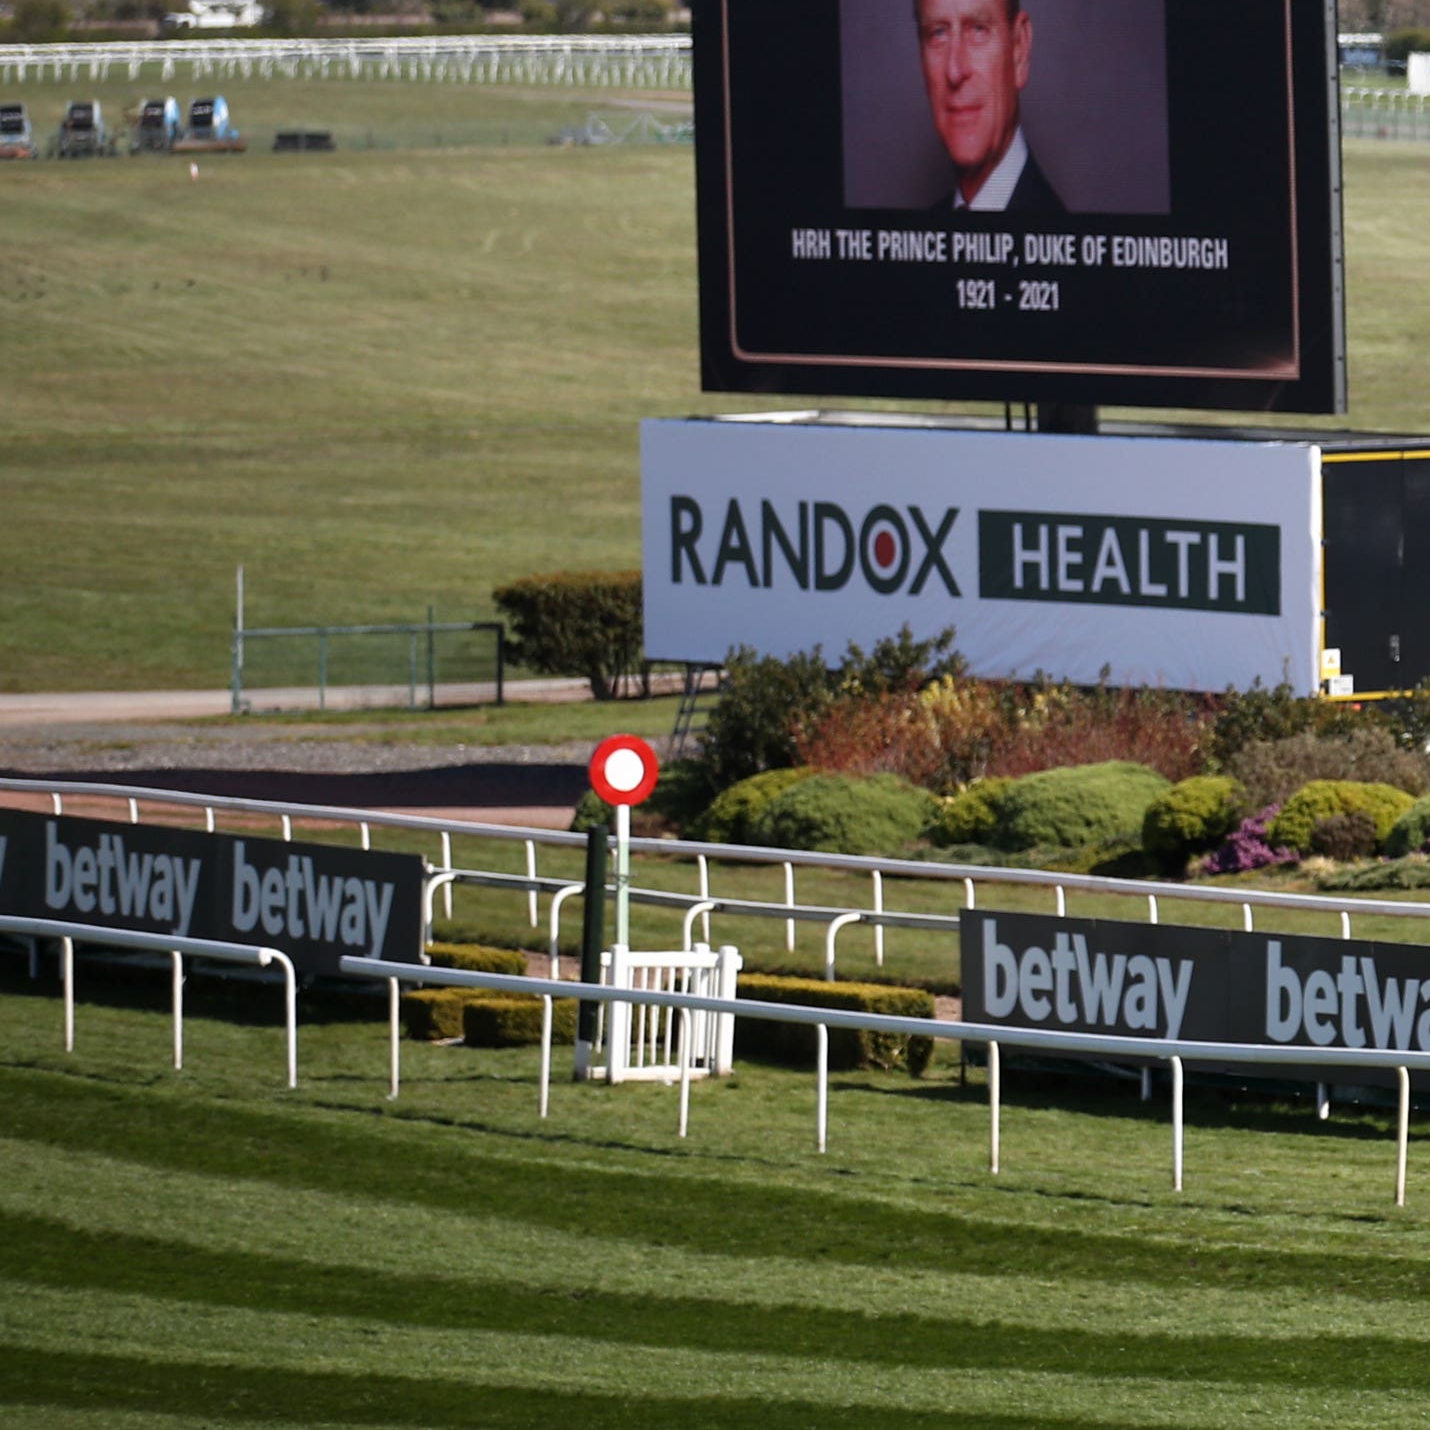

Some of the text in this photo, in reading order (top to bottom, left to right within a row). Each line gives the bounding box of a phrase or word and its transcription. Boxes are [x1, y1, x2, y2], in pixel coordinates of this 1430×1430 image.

[792, 229, 1229, 269] HRH THE PRINCE PHILIP, DUKE OF EDINBURGH
[957, 280, 995, 309] 1921
[1019, 281, 1059, 310] 2021
[670, 494, 1246, 602] RANDOX HEALTH
[45, 820, 200, 937] betway
[233, 841, 394, 959] betway
[982, 918, 1194, 1059] betway
